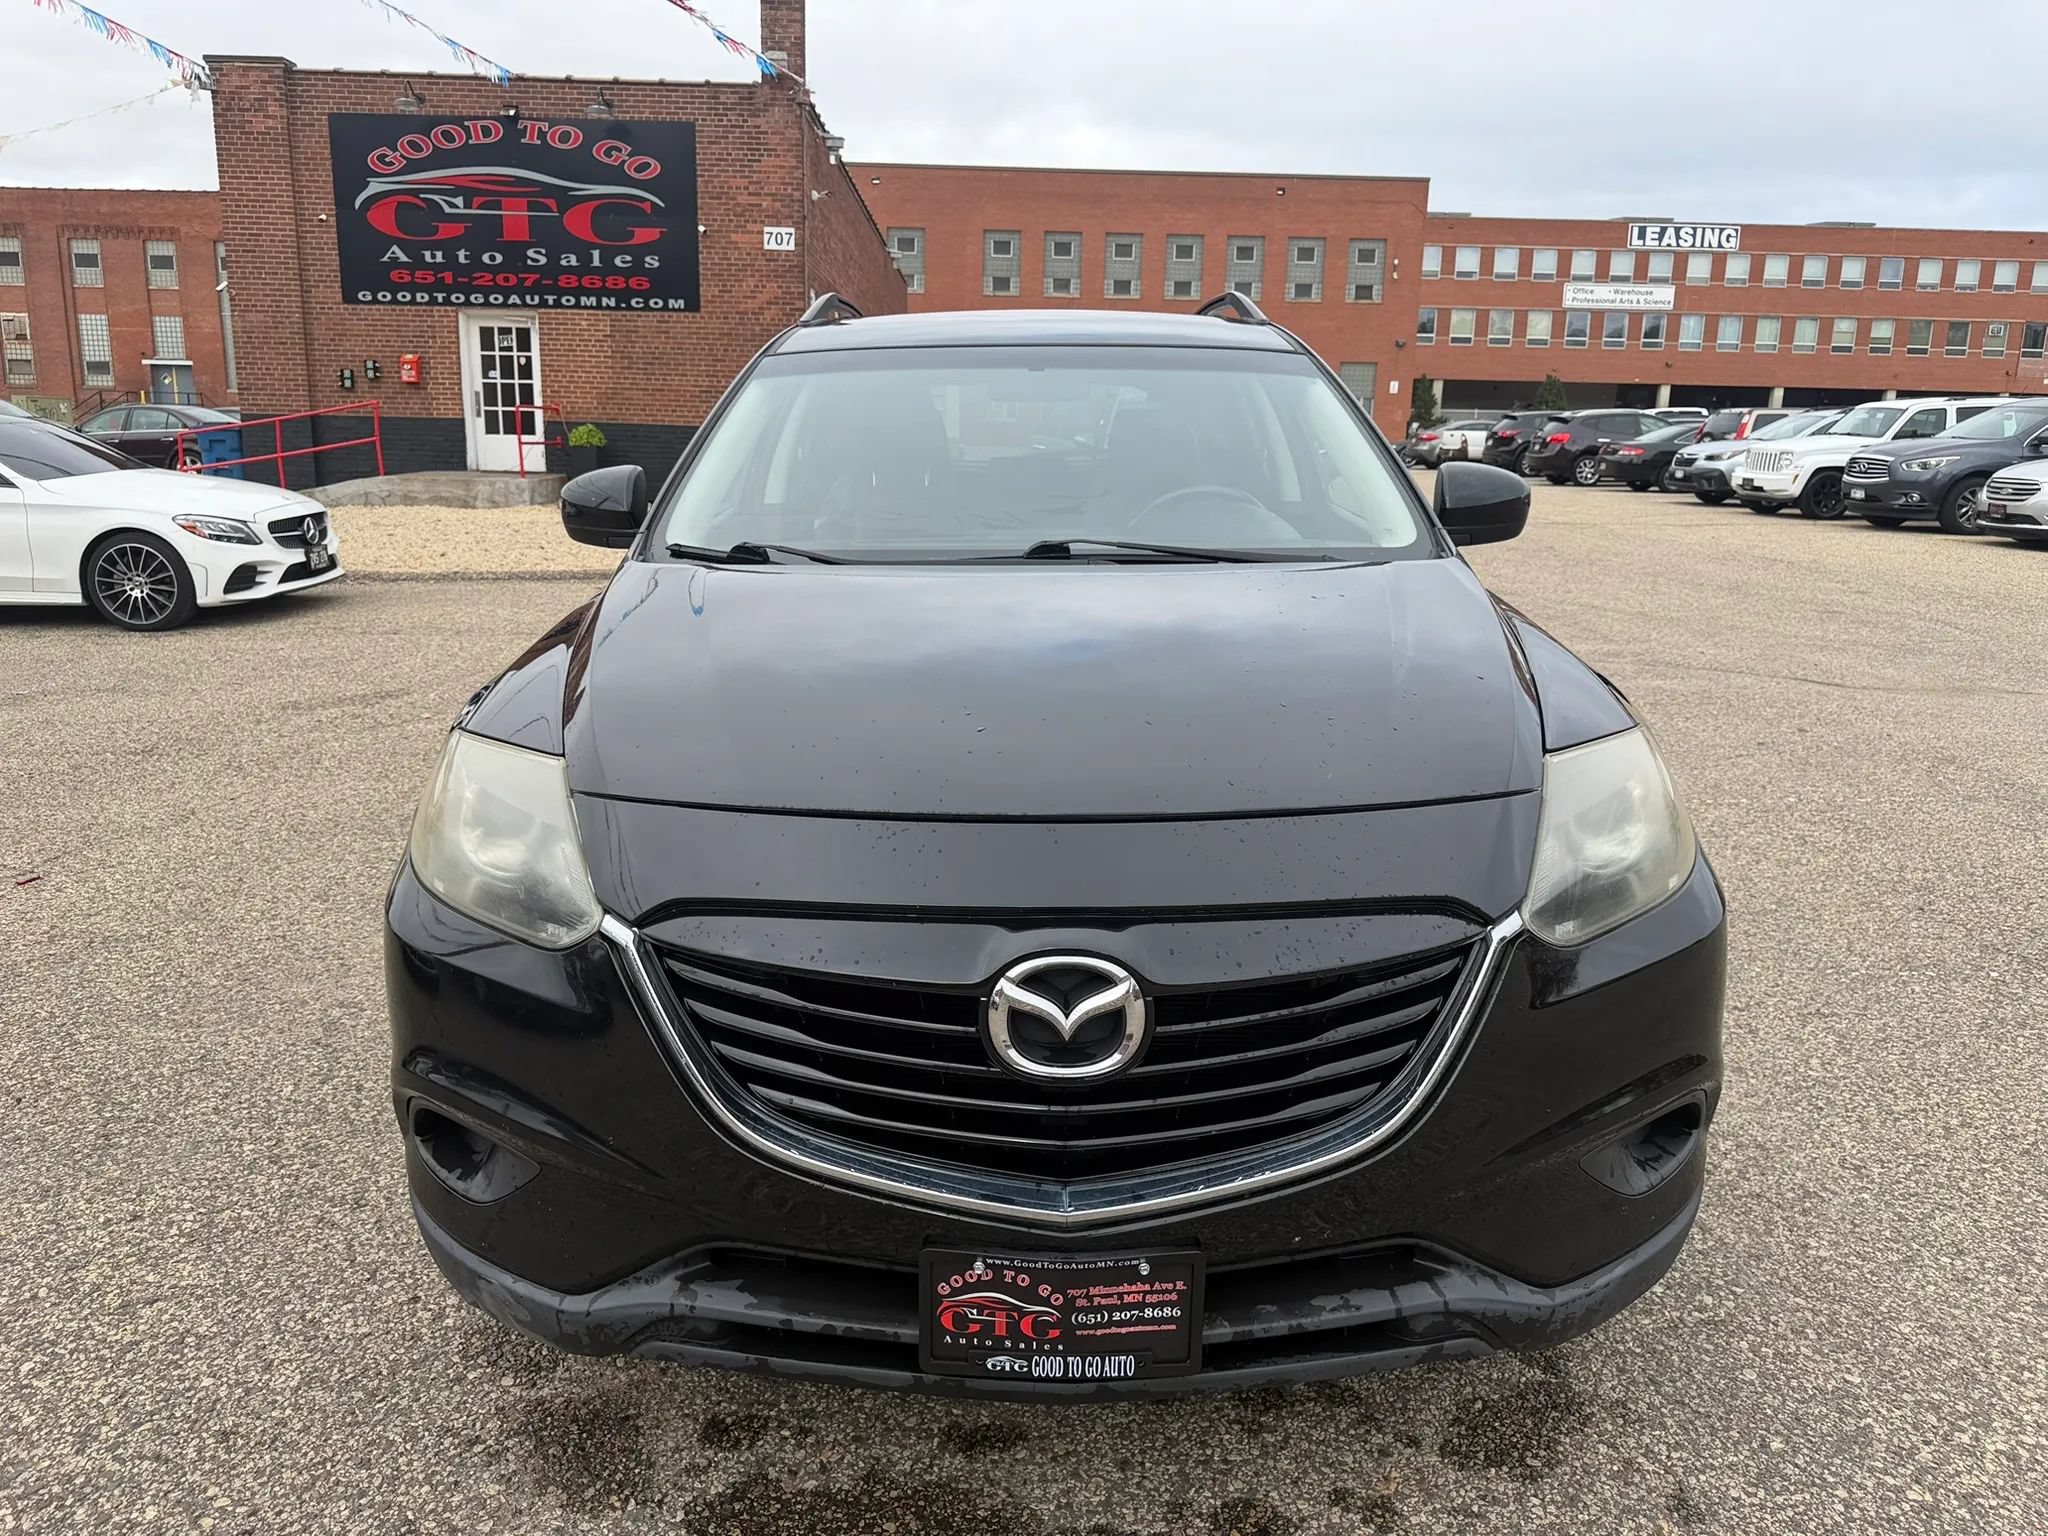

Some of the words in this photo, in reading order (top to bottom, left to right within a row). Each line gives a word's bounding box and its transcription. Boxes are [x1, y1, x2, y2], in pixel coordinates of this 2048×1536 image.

[366, 119, 504, 174] GOOD
[517, 119, 583, 149] TO
[592, 139, 661, 180] GO
[366, 194, 668, 246] GTG
[765, 231, 794, 246] 707
[1631, 226, 1737, 249] LEASING
[379, 244, 503, 265] Auto
[526, 247, 661, 269] Sales
[389, 269, 651, 291] 651-207-8686
[357, 290, 686, 310] GOODTOGOAUTOMN.COM
[1571, 296, 1617, 304] Professional
[1643, 298, 1671, 306] Science
[1572, 287, 1594, 295] Office
[1613, 288, 1654, 296] Warehouse
[986, 1257, 1140, 1270] www.GoodToGoAutoMN.com
[937, 1268, 993, 1295] GOOD
[1003, 1269, 1030, 1287] TO
[1038, 1284, 1064, 1306] GO
[1066, 1288, 1087, 1298] 707
[1152, 1281, 1174, 1291] Ave
[1123, 1293, 1143, 1304] MN
[1145, 1292, 1178, 1304] 55106
[940, 1307, 1063, 1339] GTG
[1071, 1310, 1109, 1325] (651)
[1112, 1306, 1181, 1321] 207-8686
[944, 1335, 992, 1346] Auto
[1004, 1339, 1064, 1351] Sales
[1031, 1355, 1064, 1377] GOOD
[1067, 1356, 1082, 1377] TO
[1085, 1356, 1101, 1377] GO
[1102, 1355, 1135, 1377] AUTO
